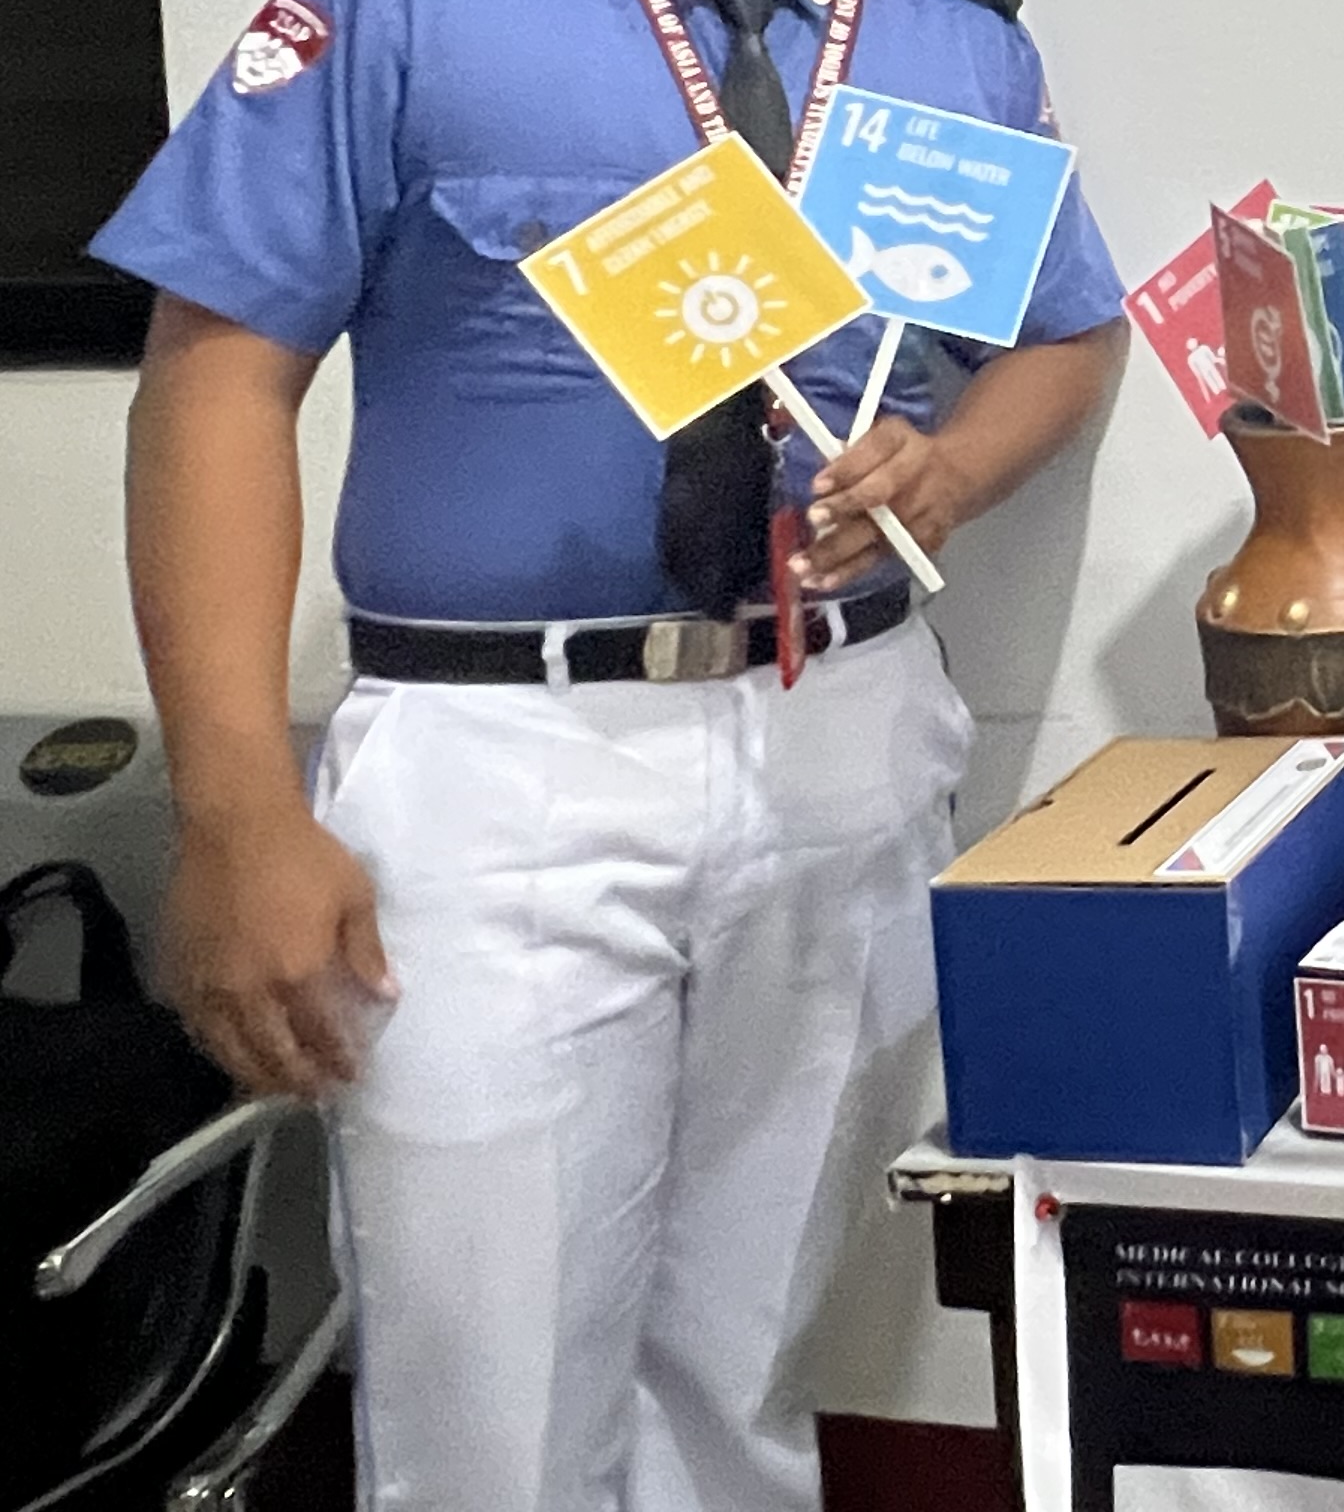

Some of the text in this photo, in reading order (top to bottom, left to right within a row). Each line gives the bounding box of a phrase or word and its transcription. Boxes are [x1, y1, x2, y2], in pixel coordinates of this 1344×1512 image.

[841, 102, 891, 153] 14
[546, 249, 589, 296] 7
[1135, 291, 1164, 324] 1
[1304, 989, 1315, 1020] 1
